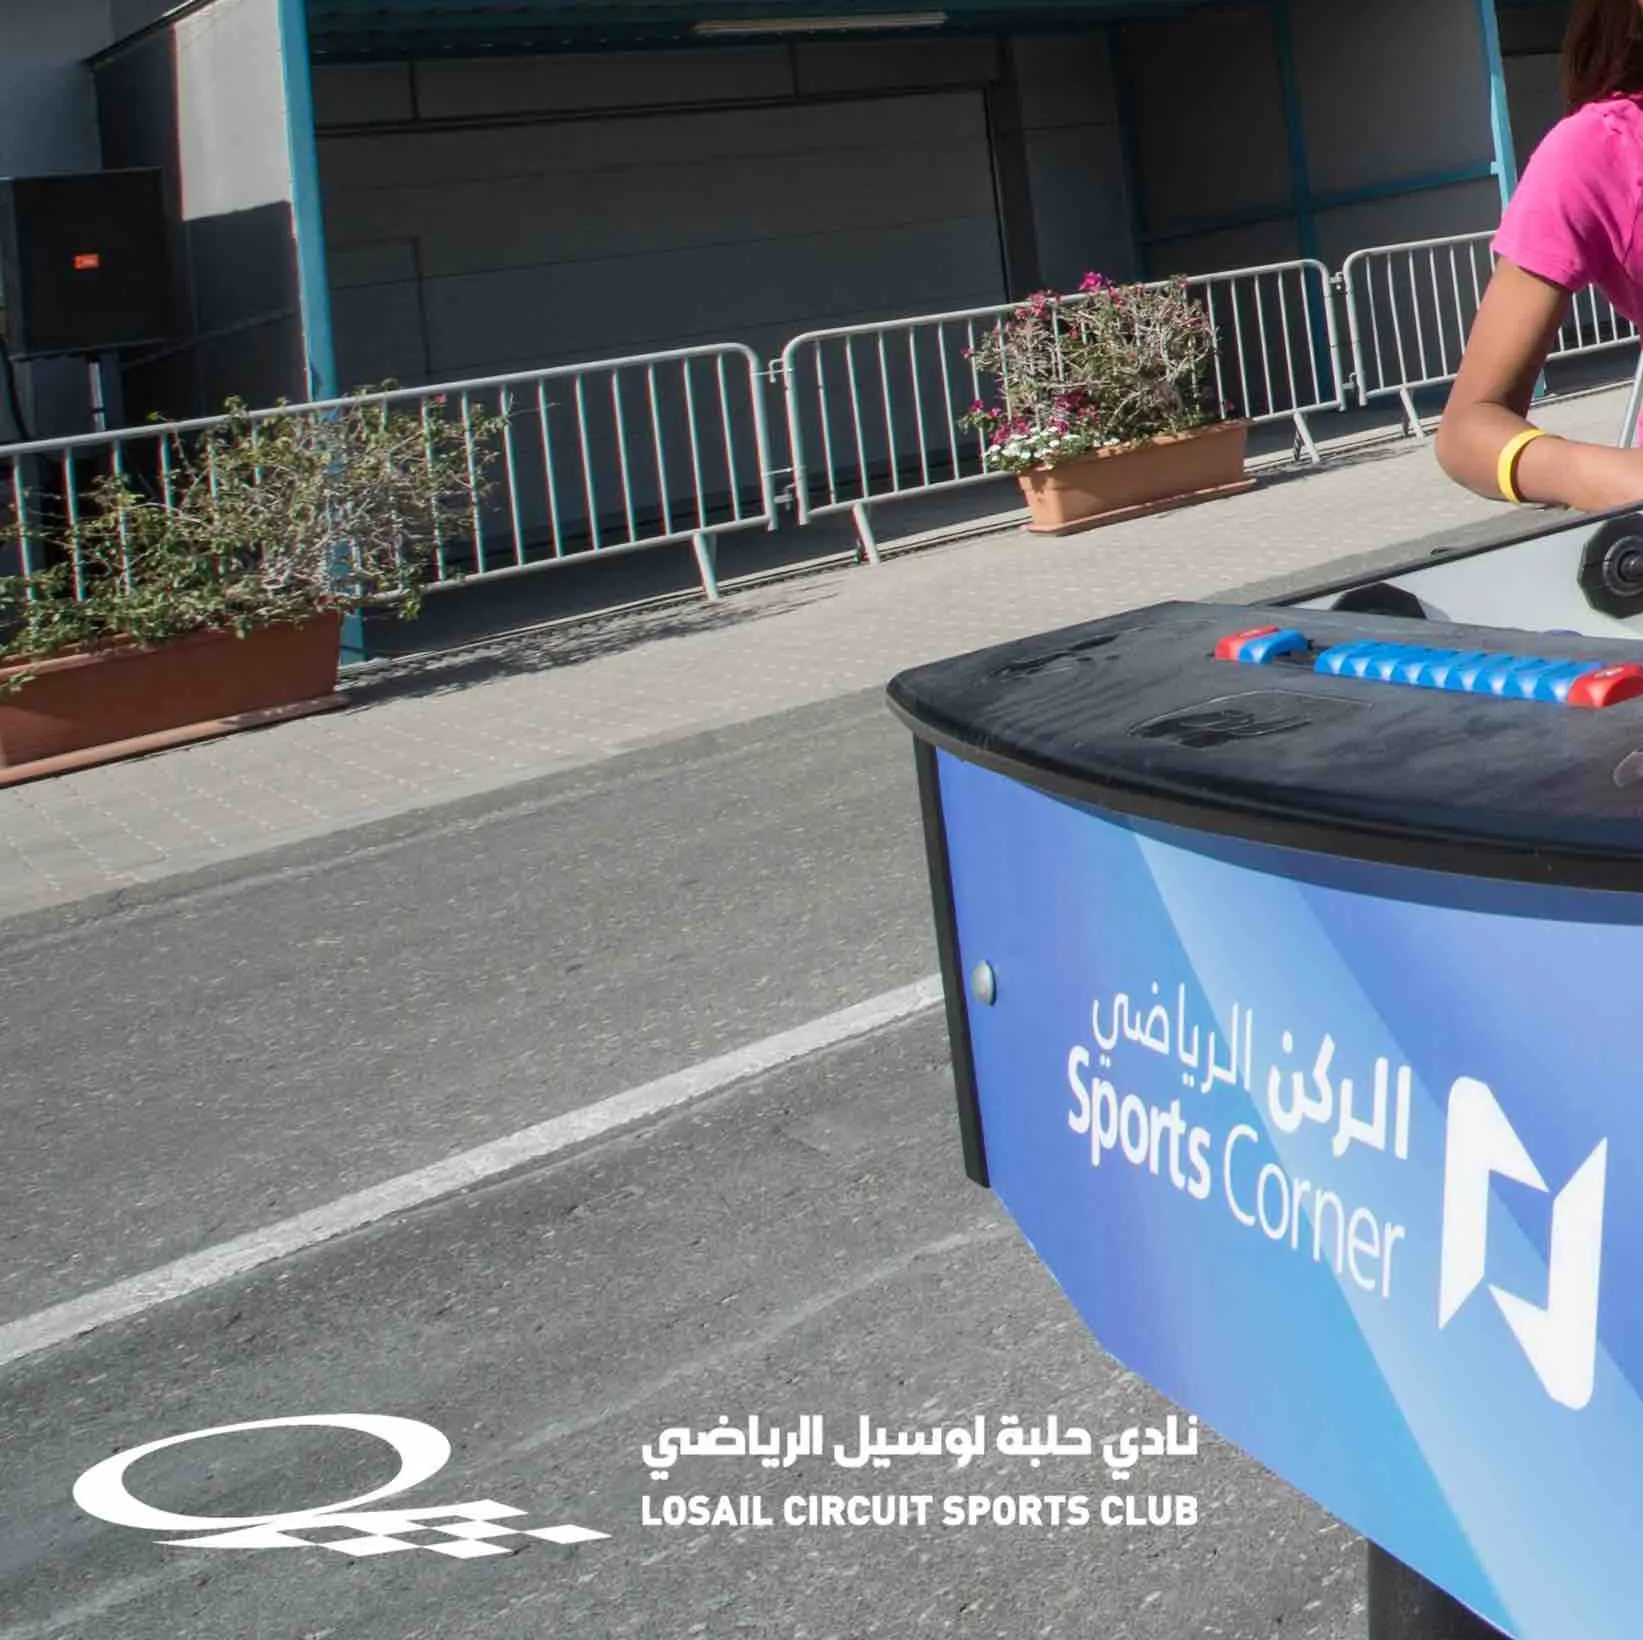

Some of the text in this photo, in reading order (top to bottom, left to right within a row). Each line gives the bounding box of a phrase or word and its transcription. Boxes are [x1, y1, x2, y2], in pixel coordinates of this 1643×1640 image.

[1066, 1044, 1407, 1301] Sports Corner
[1090, 981, 1412, 1160] الركن الرياضي
